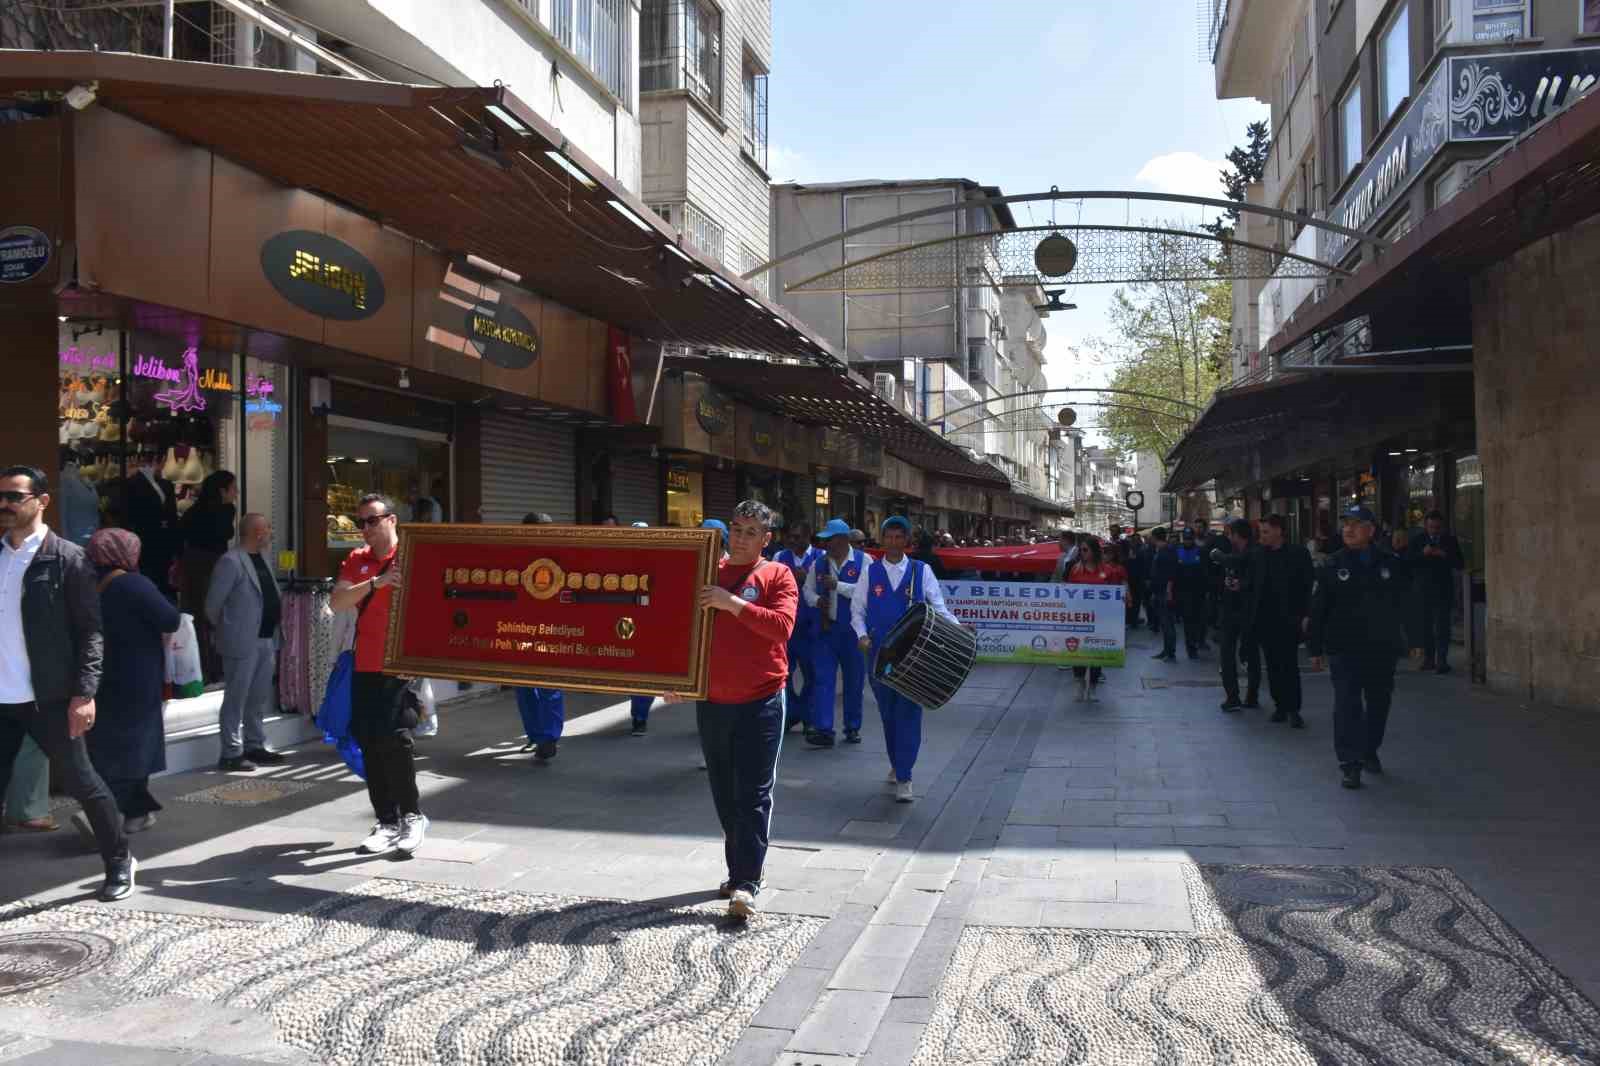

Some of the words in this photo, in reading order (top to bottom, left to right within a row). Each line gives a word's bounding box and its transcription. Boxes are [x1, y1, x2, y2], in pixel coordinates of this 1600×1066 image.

[1374, 135, 1408, 207] MODA
[971, 586, 1124, 601] BELEDİYESİ
[954, 608, 1019, 620] PEHLİVAN
[1023, 610, 1096, 624] GÜREŞLERİ
[496, 621, 537, 637] Şahinbey
